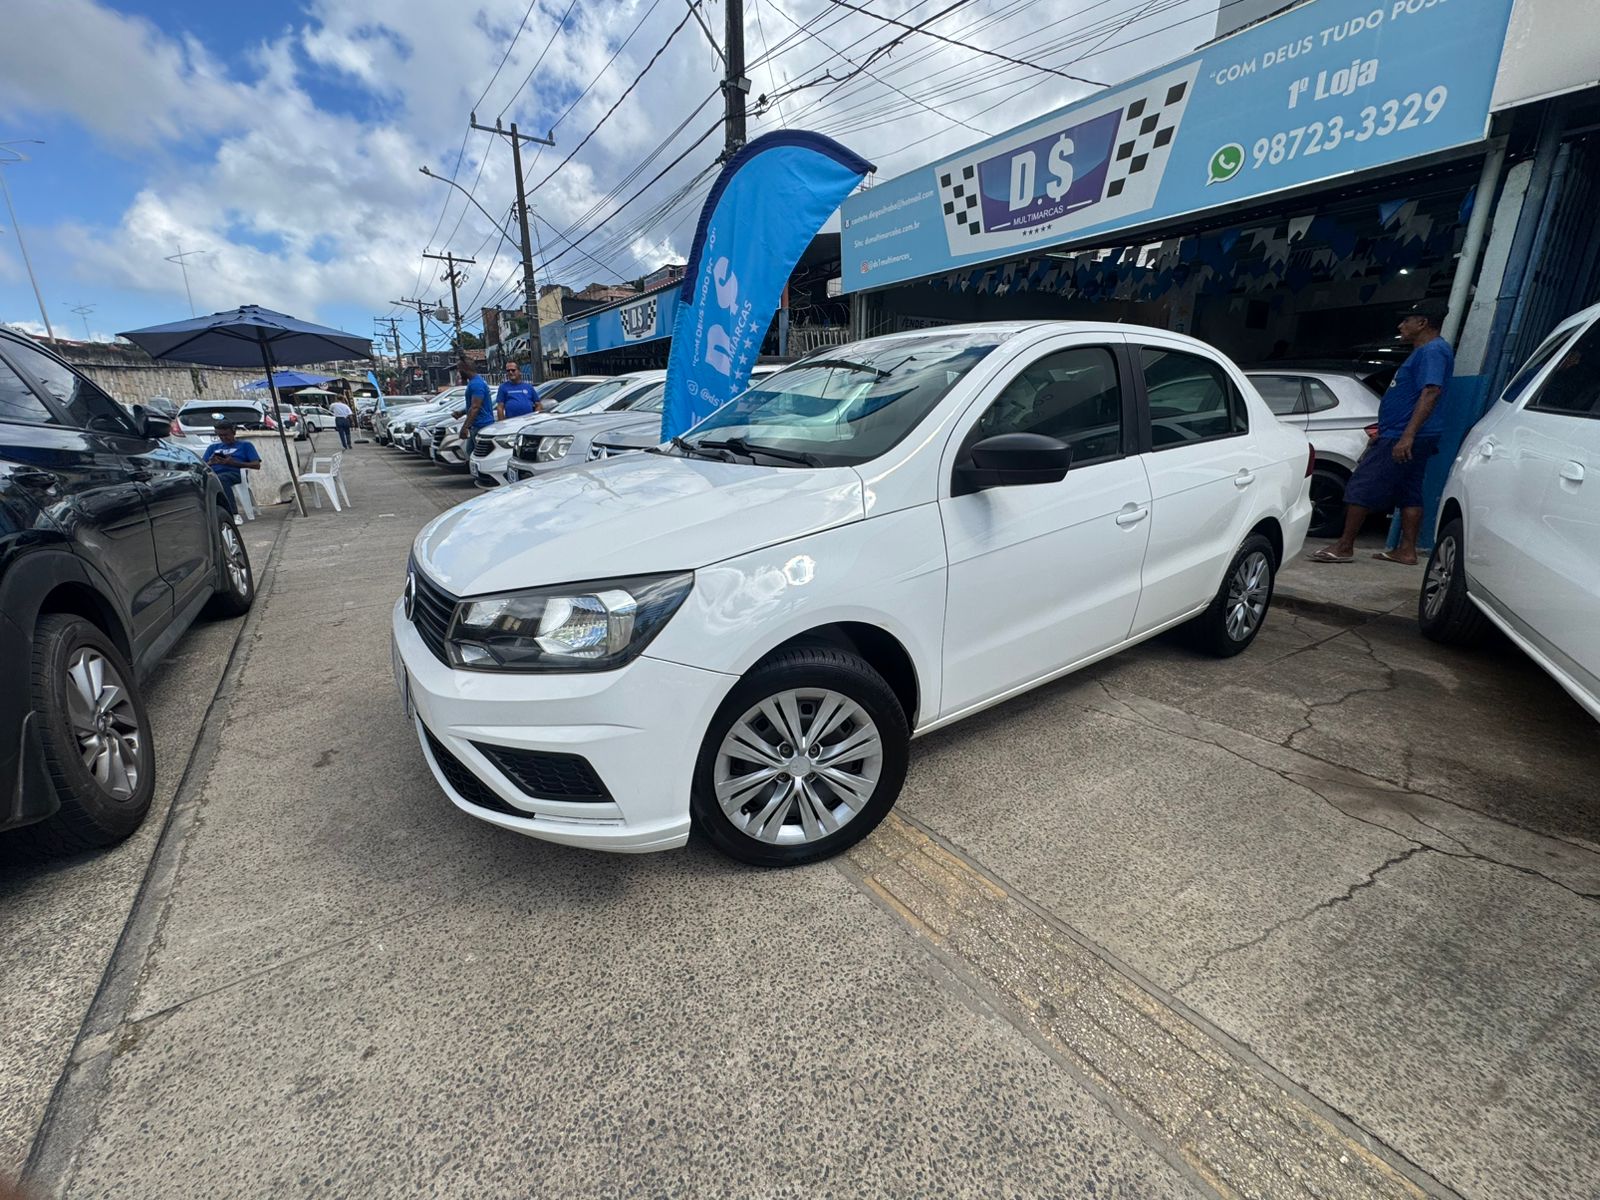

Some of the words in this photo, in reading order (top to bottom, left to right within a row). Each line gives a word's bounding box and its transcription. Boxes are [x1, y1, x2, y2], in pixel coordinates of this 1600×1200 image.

[1262, 36, 1313, 69] DEUS
[1319, 9, 1384, 47] TUDO
[1314, 58, 1379, 101] Loja
[1252, 85, 1448, 169] 98723-3329
[1013, 205, 1064, 226] MULTIMARCAS
